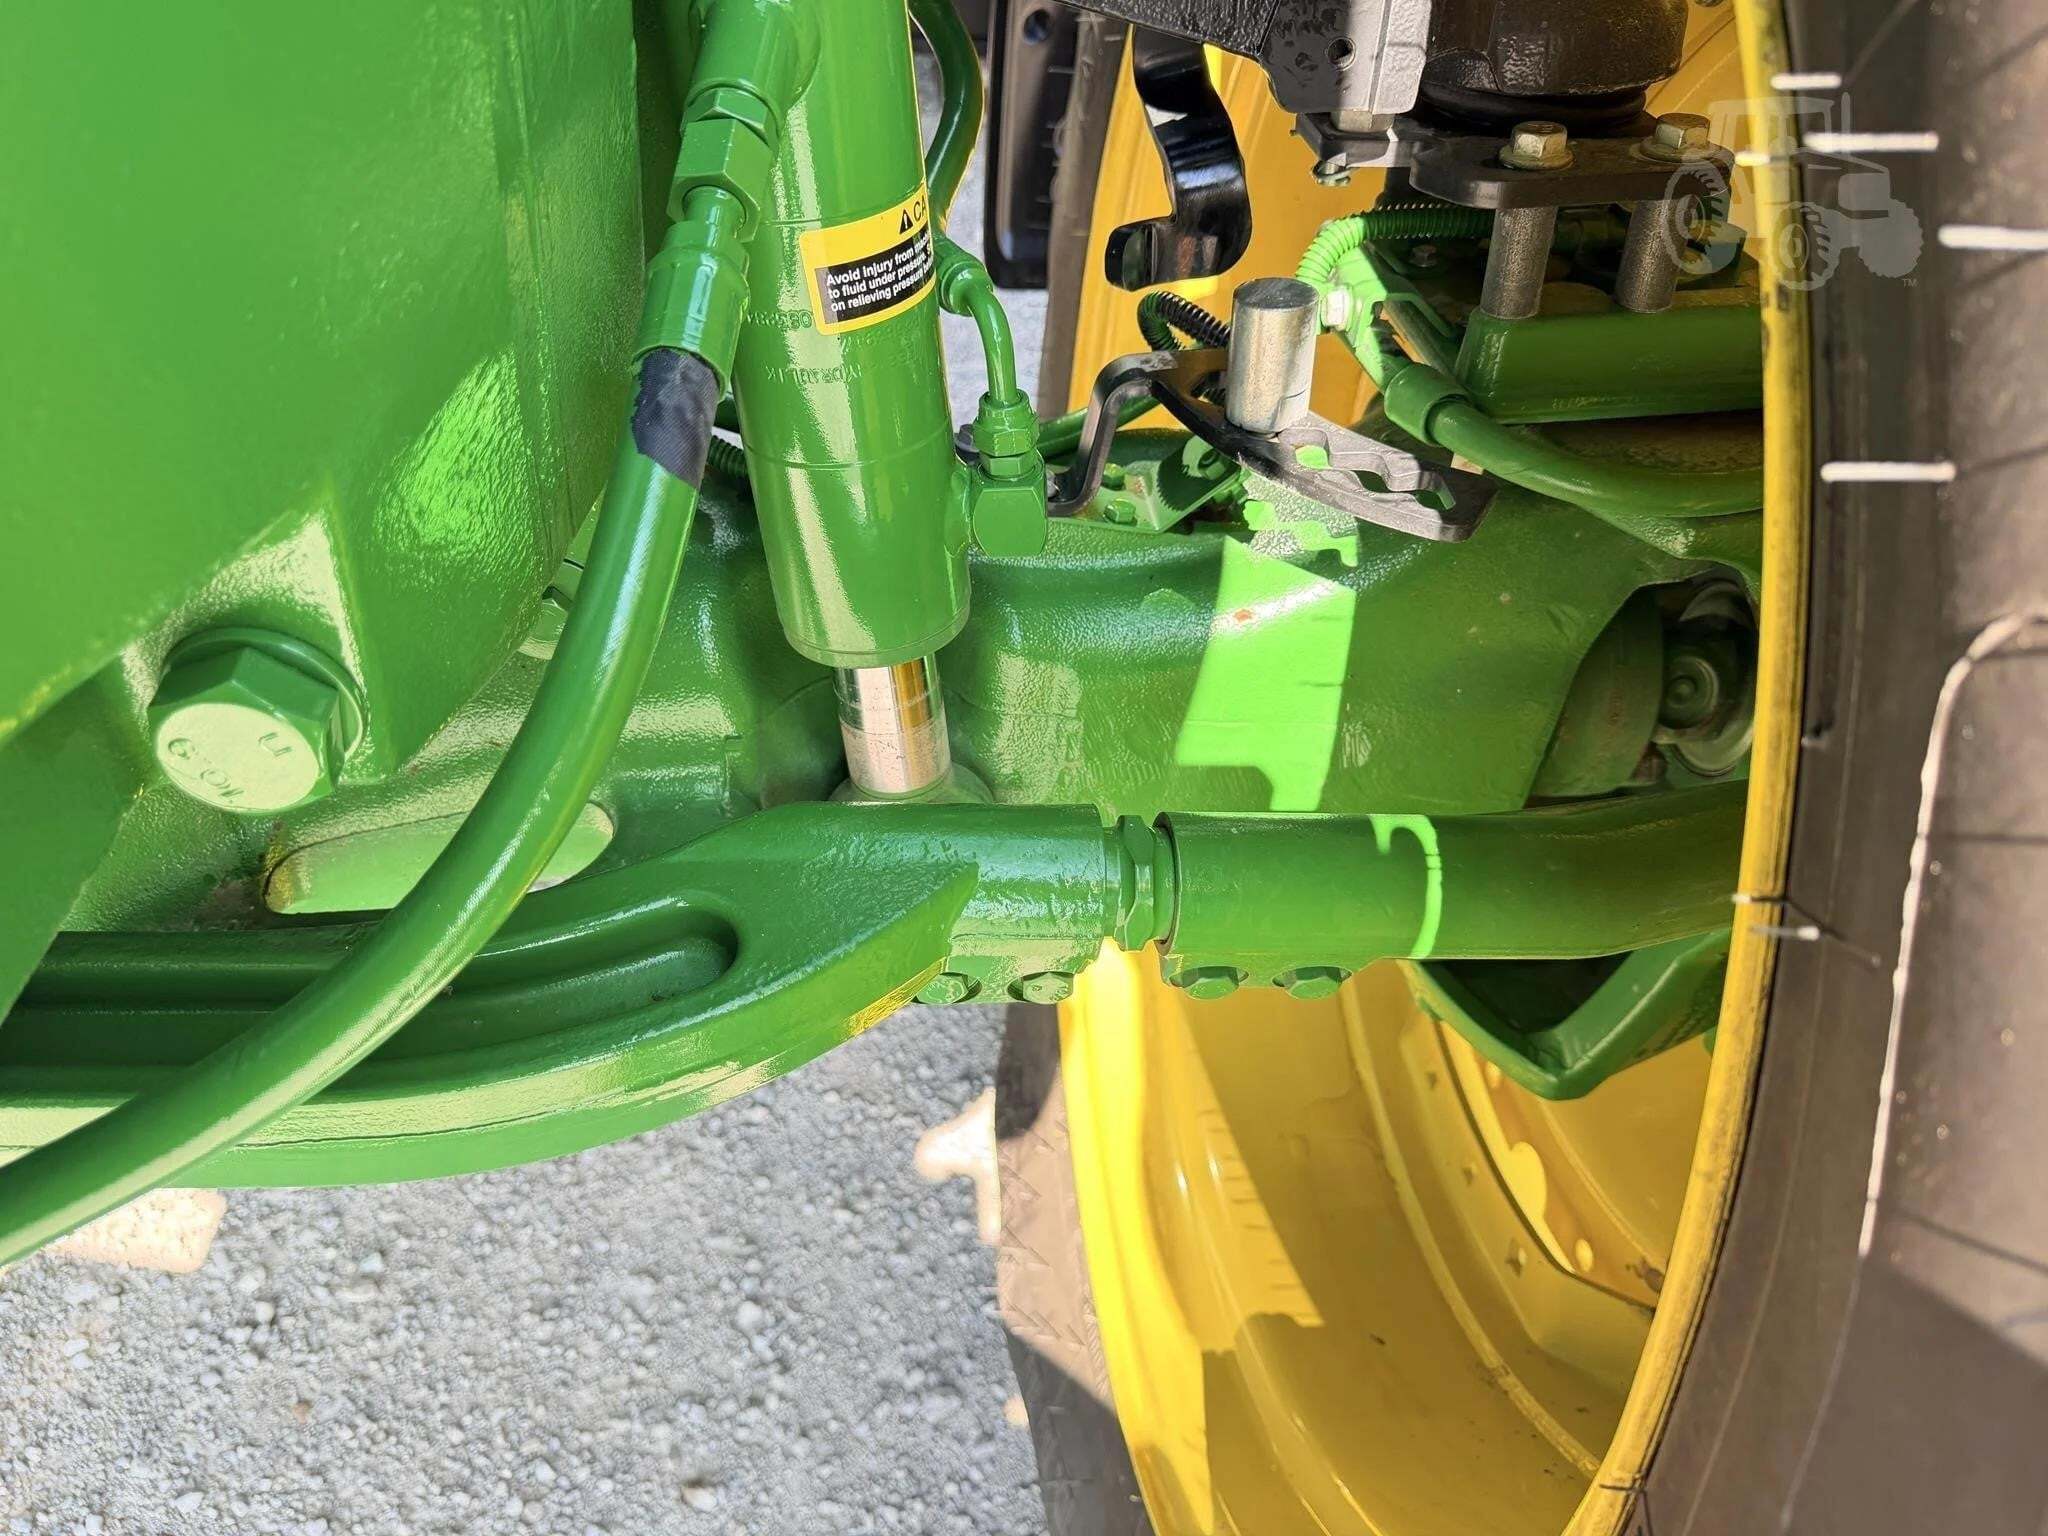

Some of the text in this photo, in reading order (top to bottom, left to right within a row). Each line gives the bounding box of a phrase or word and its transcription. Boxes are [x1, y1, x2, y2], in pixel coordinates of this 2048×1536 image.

[826, 269, 861, 287] Avoid
[863, 259, 894, 278] injury
[894, 249, 914, 265] from
[828, 287, 840, 299] to
[842, 281, 867, 298] fluid
[869, 271, 896, 289] under
[831, 300, 846, 312] on
[847, 287, 892, 310] relieving
[893, 270, 924, 296] pressure
